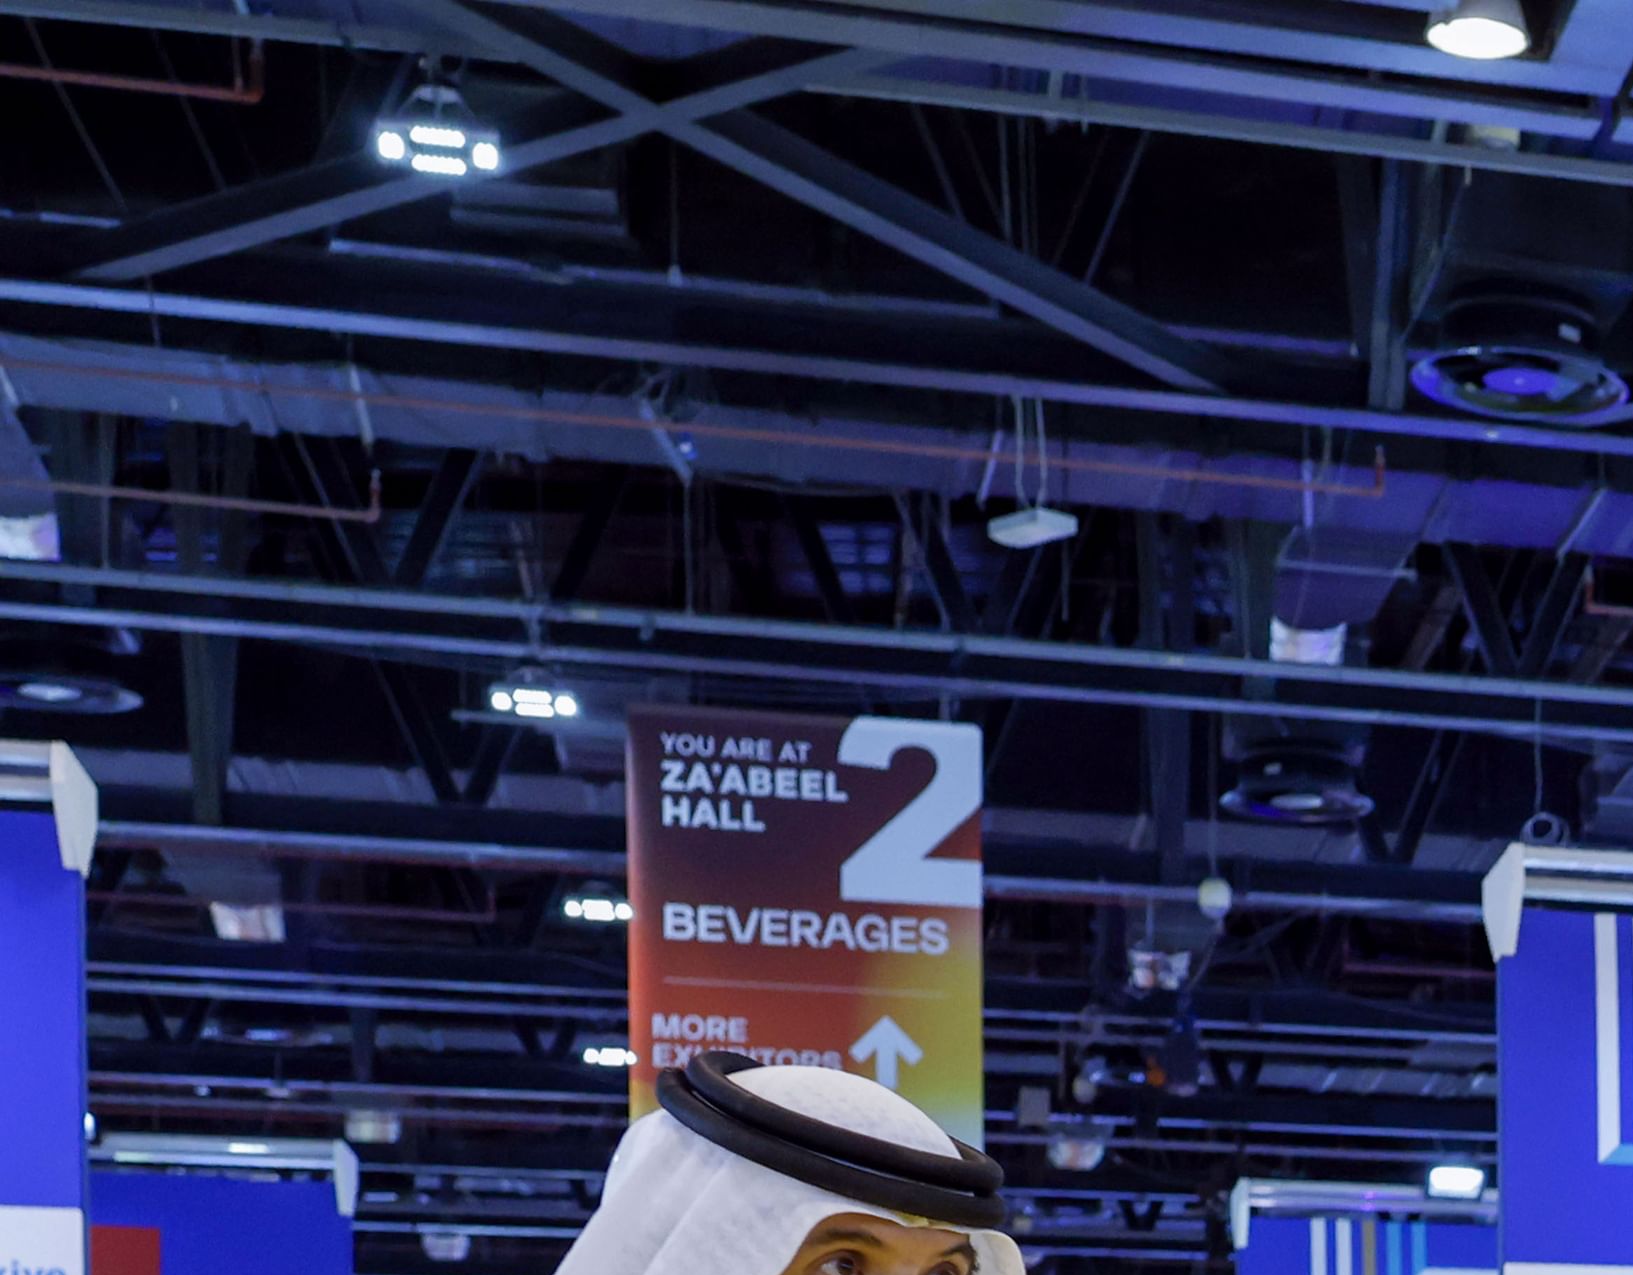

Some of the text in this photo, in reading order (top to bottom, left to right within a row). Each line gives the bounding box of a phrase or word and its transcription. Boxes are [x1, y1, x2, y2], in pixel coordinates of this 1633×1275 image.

[660, 731, 811, 763] YOU ARE AT
[660, 759, 848, 803] ZA'ABEEL
[660, 796, 767, 835] HALL
[836, 715, 983, 906] 2
[661, 901, 951, 956] BEVERAGES
[651, 1013, 748, 1043] MORE
